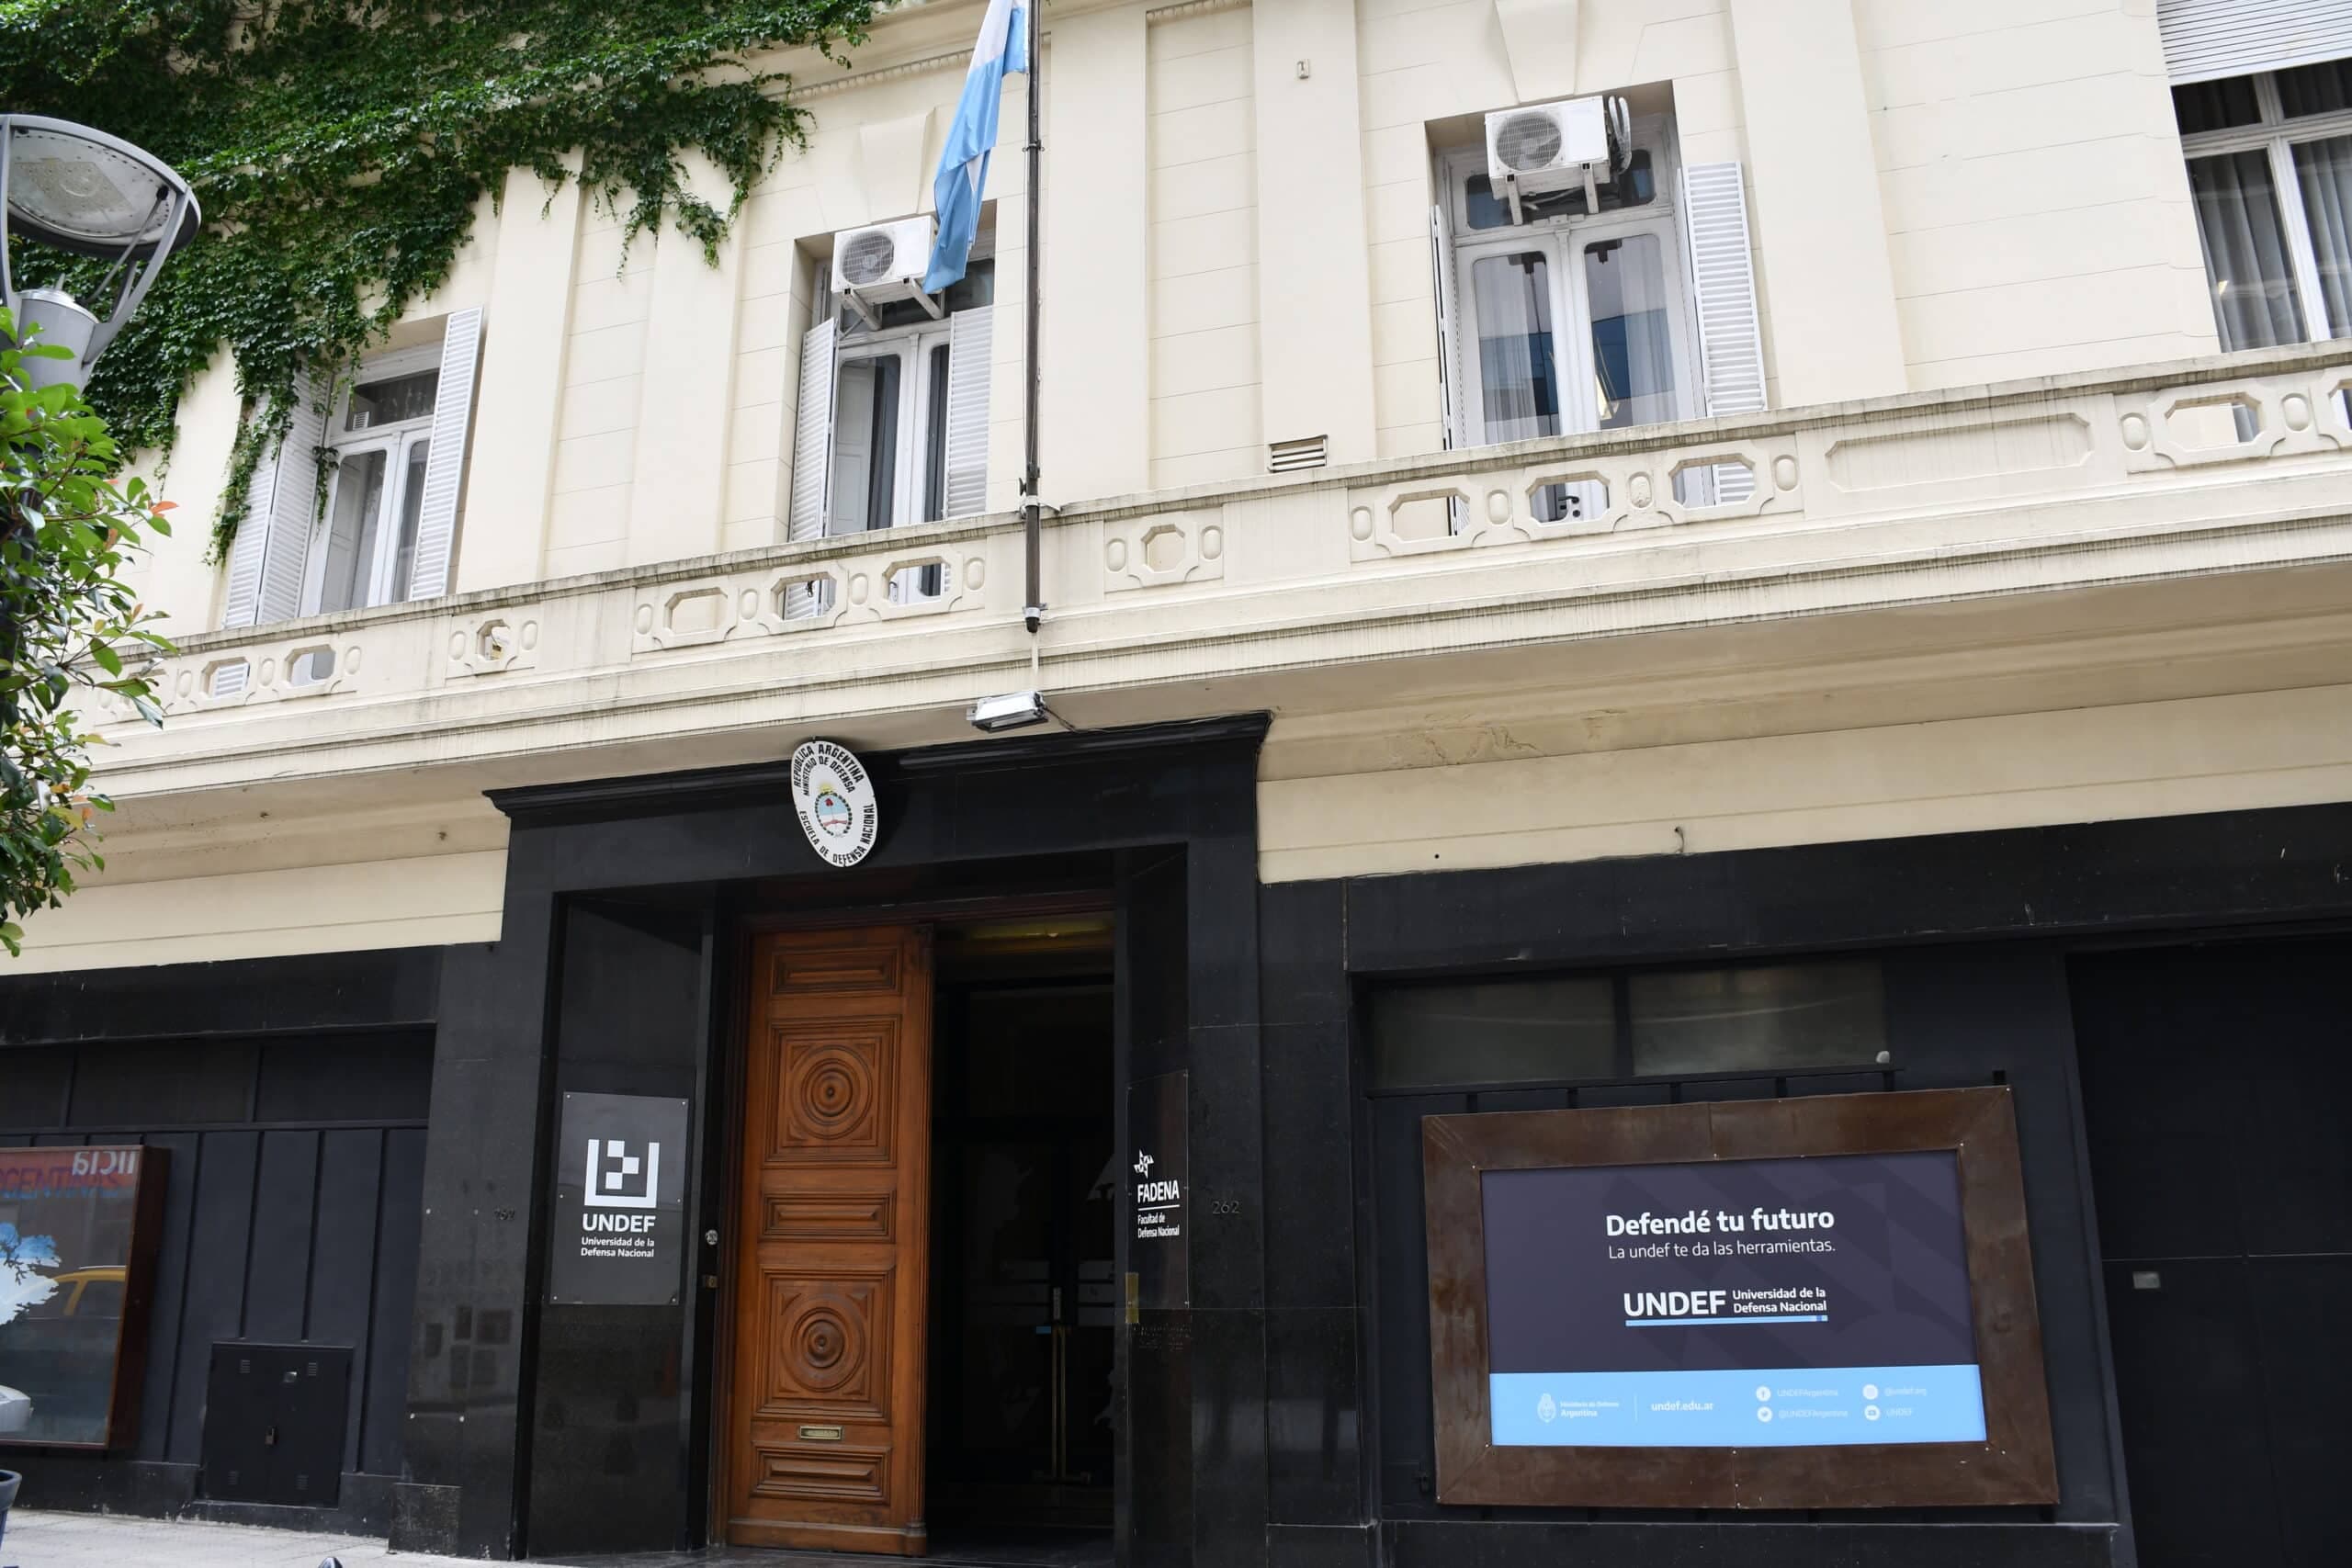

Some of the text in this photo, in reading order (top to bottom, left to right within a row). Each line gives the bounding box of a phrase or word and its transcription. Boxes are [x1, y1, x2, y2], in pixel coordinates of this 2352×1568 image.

[819, 743, 865, 784] ARGENTINA
[801, 756, 855, 796] MINISTERIO DE DEFENSA
[799, 803, 874, 864] ESCUELA DE DEFENSA NACIONAL
[1137, 1179, 1180, 1203] FADENA
[1212, 1201, 1241, 1214] 262
[582, 1213, 656, 1234] UNDEF
[1137, 1213, 1166, 1224] Facultad de
[1606, 1207, 1835, 1236] Defendé tu futuro
[1137, 1224, 1180, 1239] Defensa Nacional
[581, 1236, 655, 1247] Universidad de la
[1609, 1237, 1836, 1259] La undef te da las herramientas.
[581, 1247, 654, 1258] Defensa Nacional
[1733, 1287, 1826, 1300] Universidad de la
[1623, 1290, 1726, 1316] UNDEF
[1734, 1300, 1827, 1314] Defensa Nacional
[1650, 1400, 1714, 1412] undef.edu.ar
[1560, 1409, 1598, 1419] Argentina
